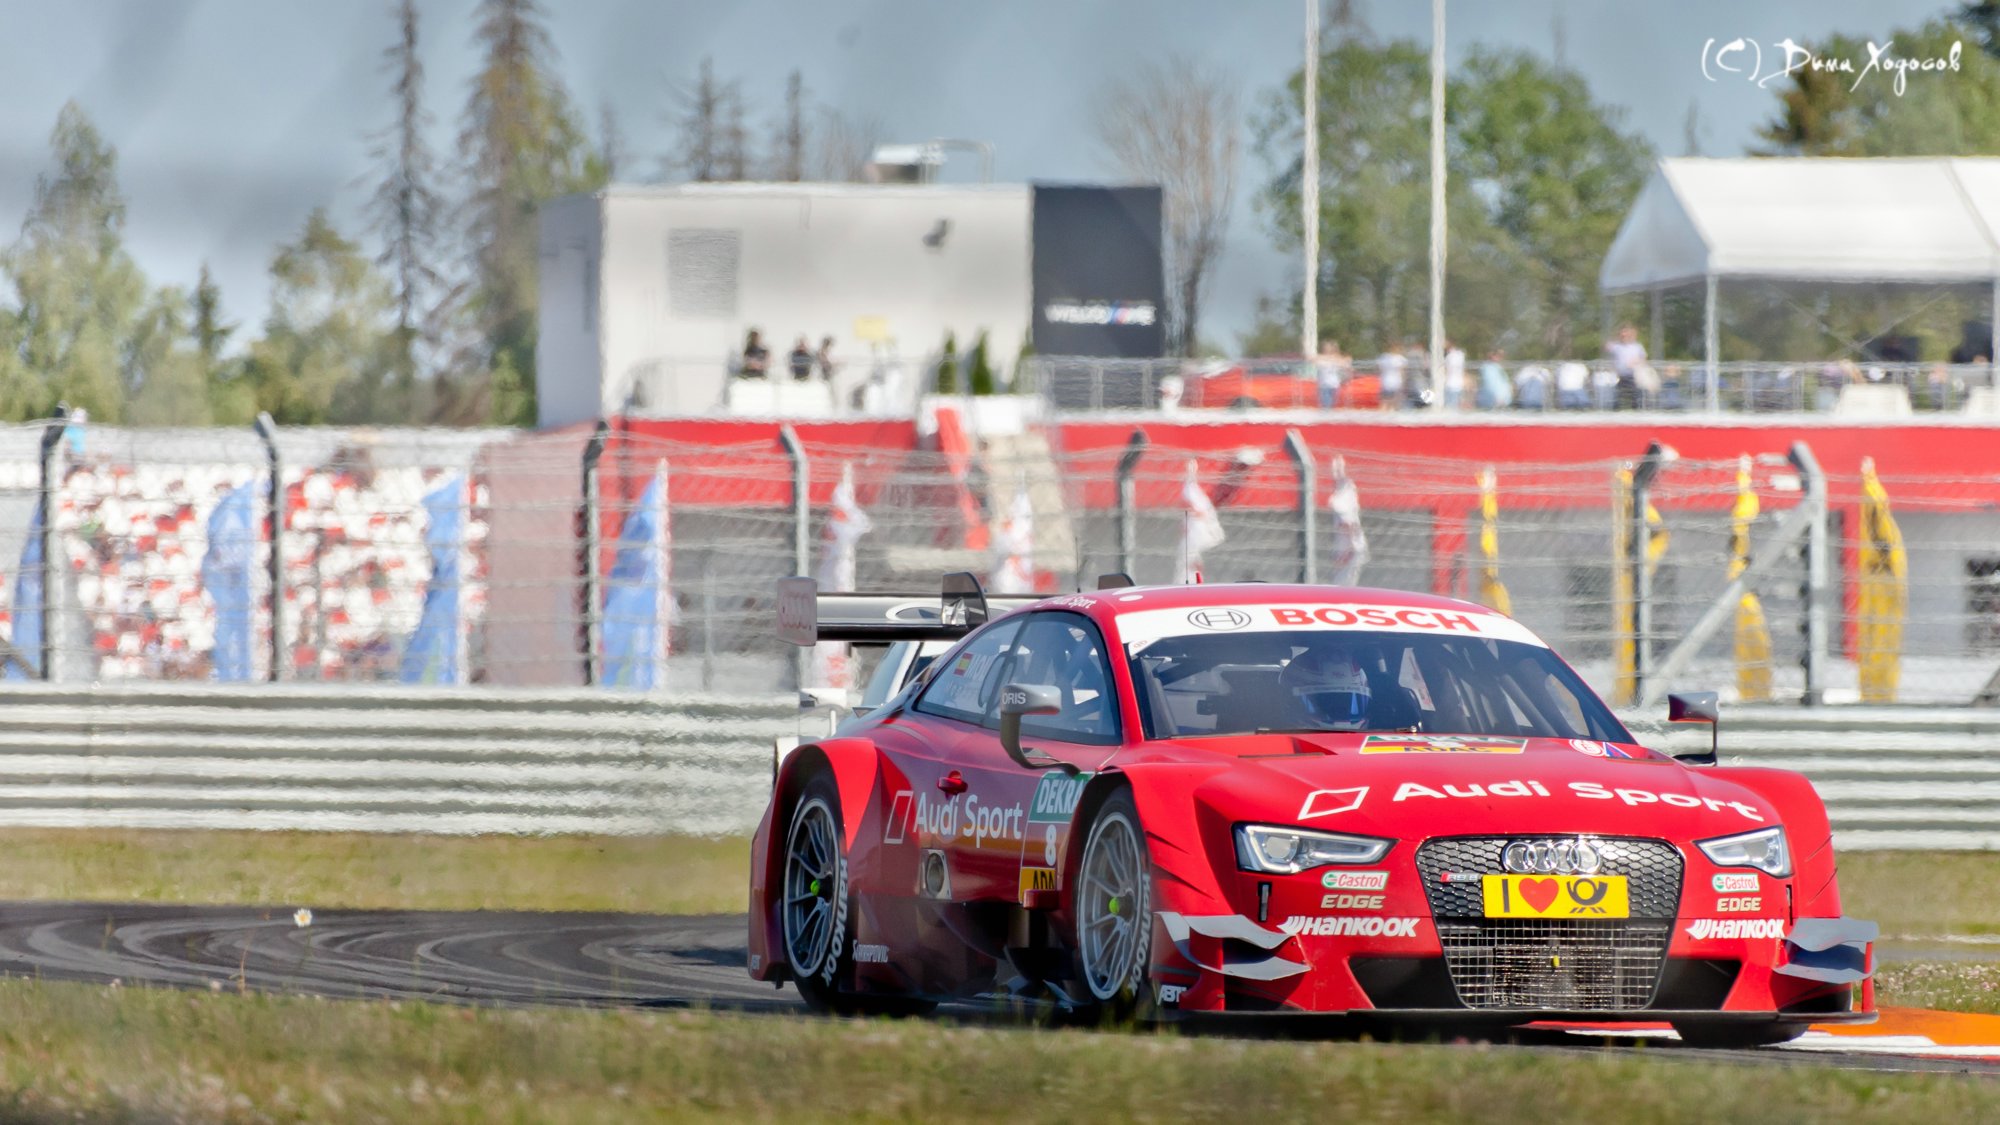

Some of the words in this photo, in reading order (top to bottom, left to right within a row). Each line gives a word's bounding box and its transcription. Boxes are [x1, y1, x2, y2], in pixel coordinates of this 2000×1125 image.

[1268, 607, 1482, 632] BOSCH
[1001, 692, 1026, 705] ORIS
[1392, 780, 1552, 802] Audi
[1567, 781, 1764, 822] Sport
[912, 791, 960, 836] Audi
[962, 794, 1023, 849] Sport
[1044, 824, 1057, 866] 8
[1337, 873, 1384, 888] Castrol
[1725, 876, 1758, 890] Castrol
[1320, 894, 1387, 910] EDGE
[1501, 878, 1511, 913] I
[1716, 897, 1762, 912] EDGE
[1157, 984, 1188, 1007] ABT
